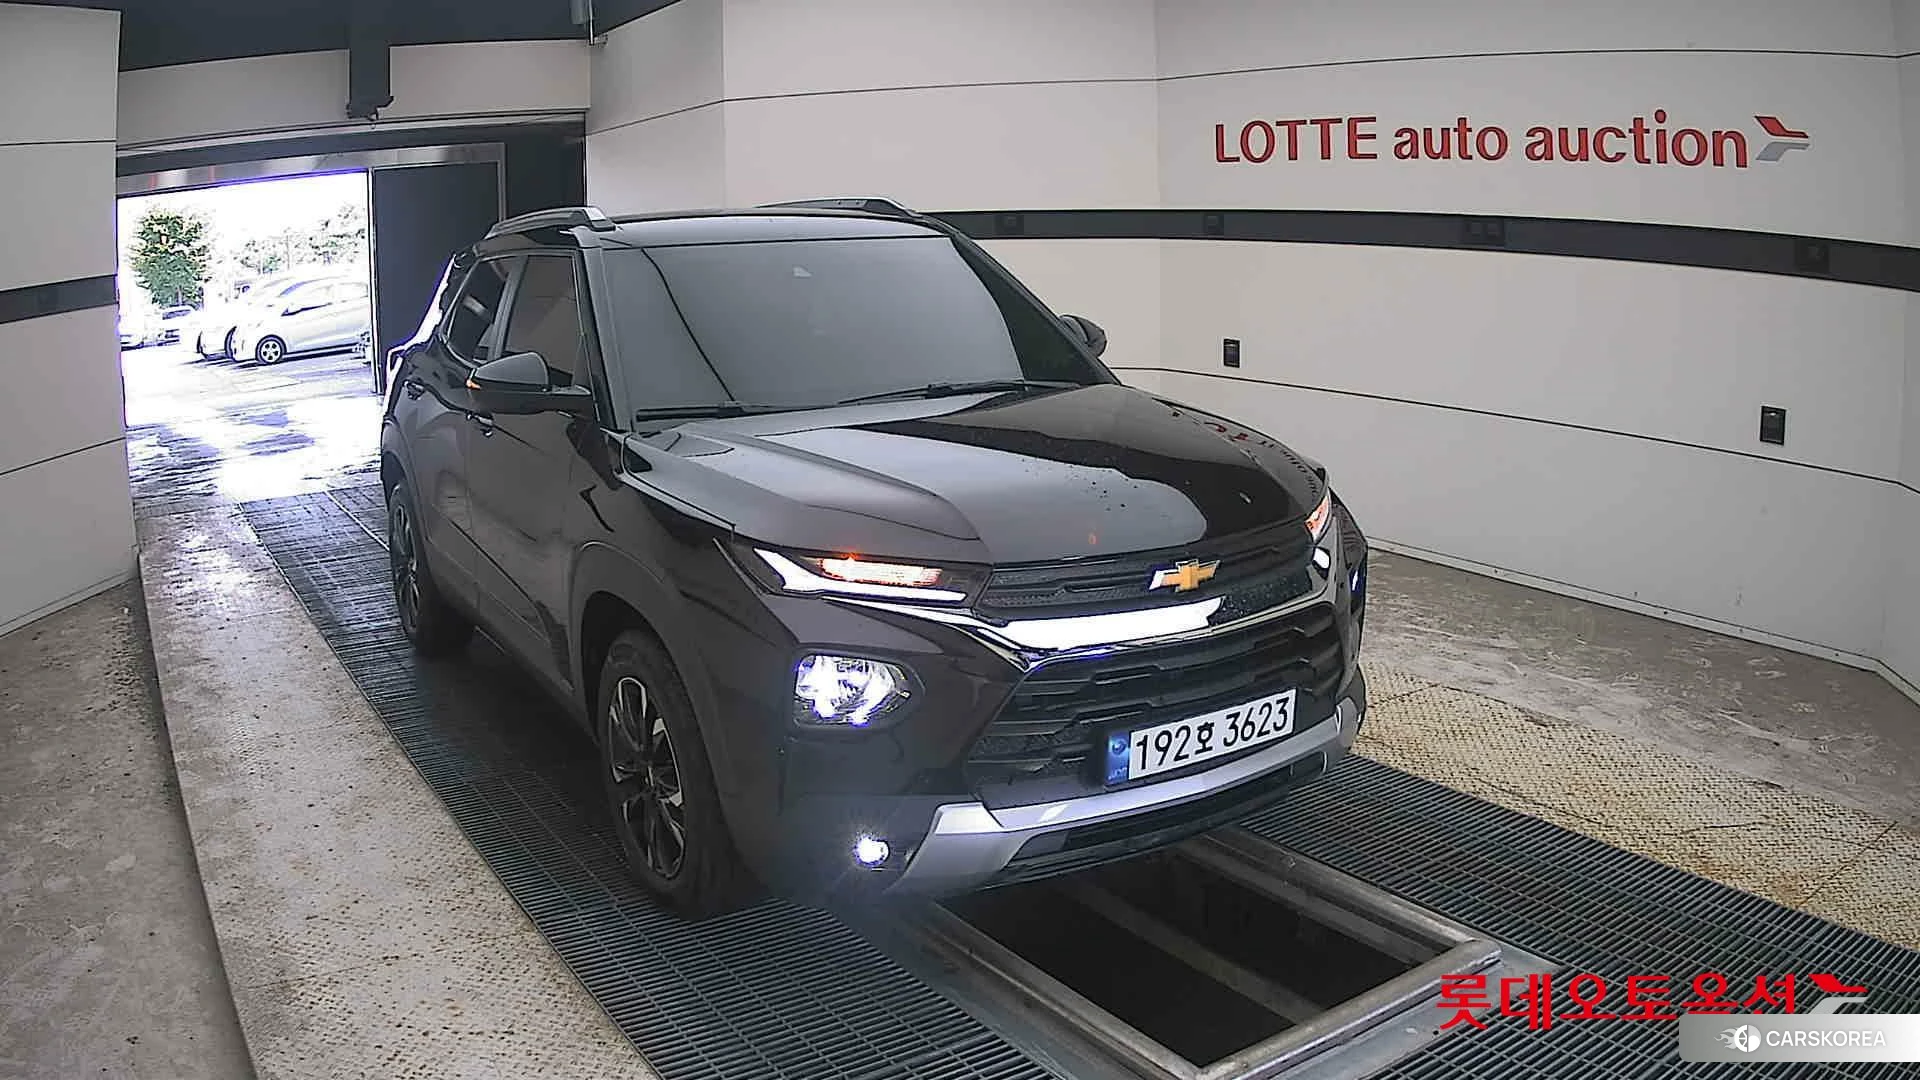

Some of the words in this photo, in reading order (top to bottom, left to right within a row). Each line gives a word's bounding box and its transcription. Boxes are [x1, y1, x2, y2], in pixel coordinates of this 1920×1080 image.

[1216, 117, 1377, 163] LOTTE
[1394, 117, 1508, 161] auto
[1525, 110, 1748, 168] auction
[1136, 720, 1215, 770] 192호
[1223, 696, 1290, 747] 3623
